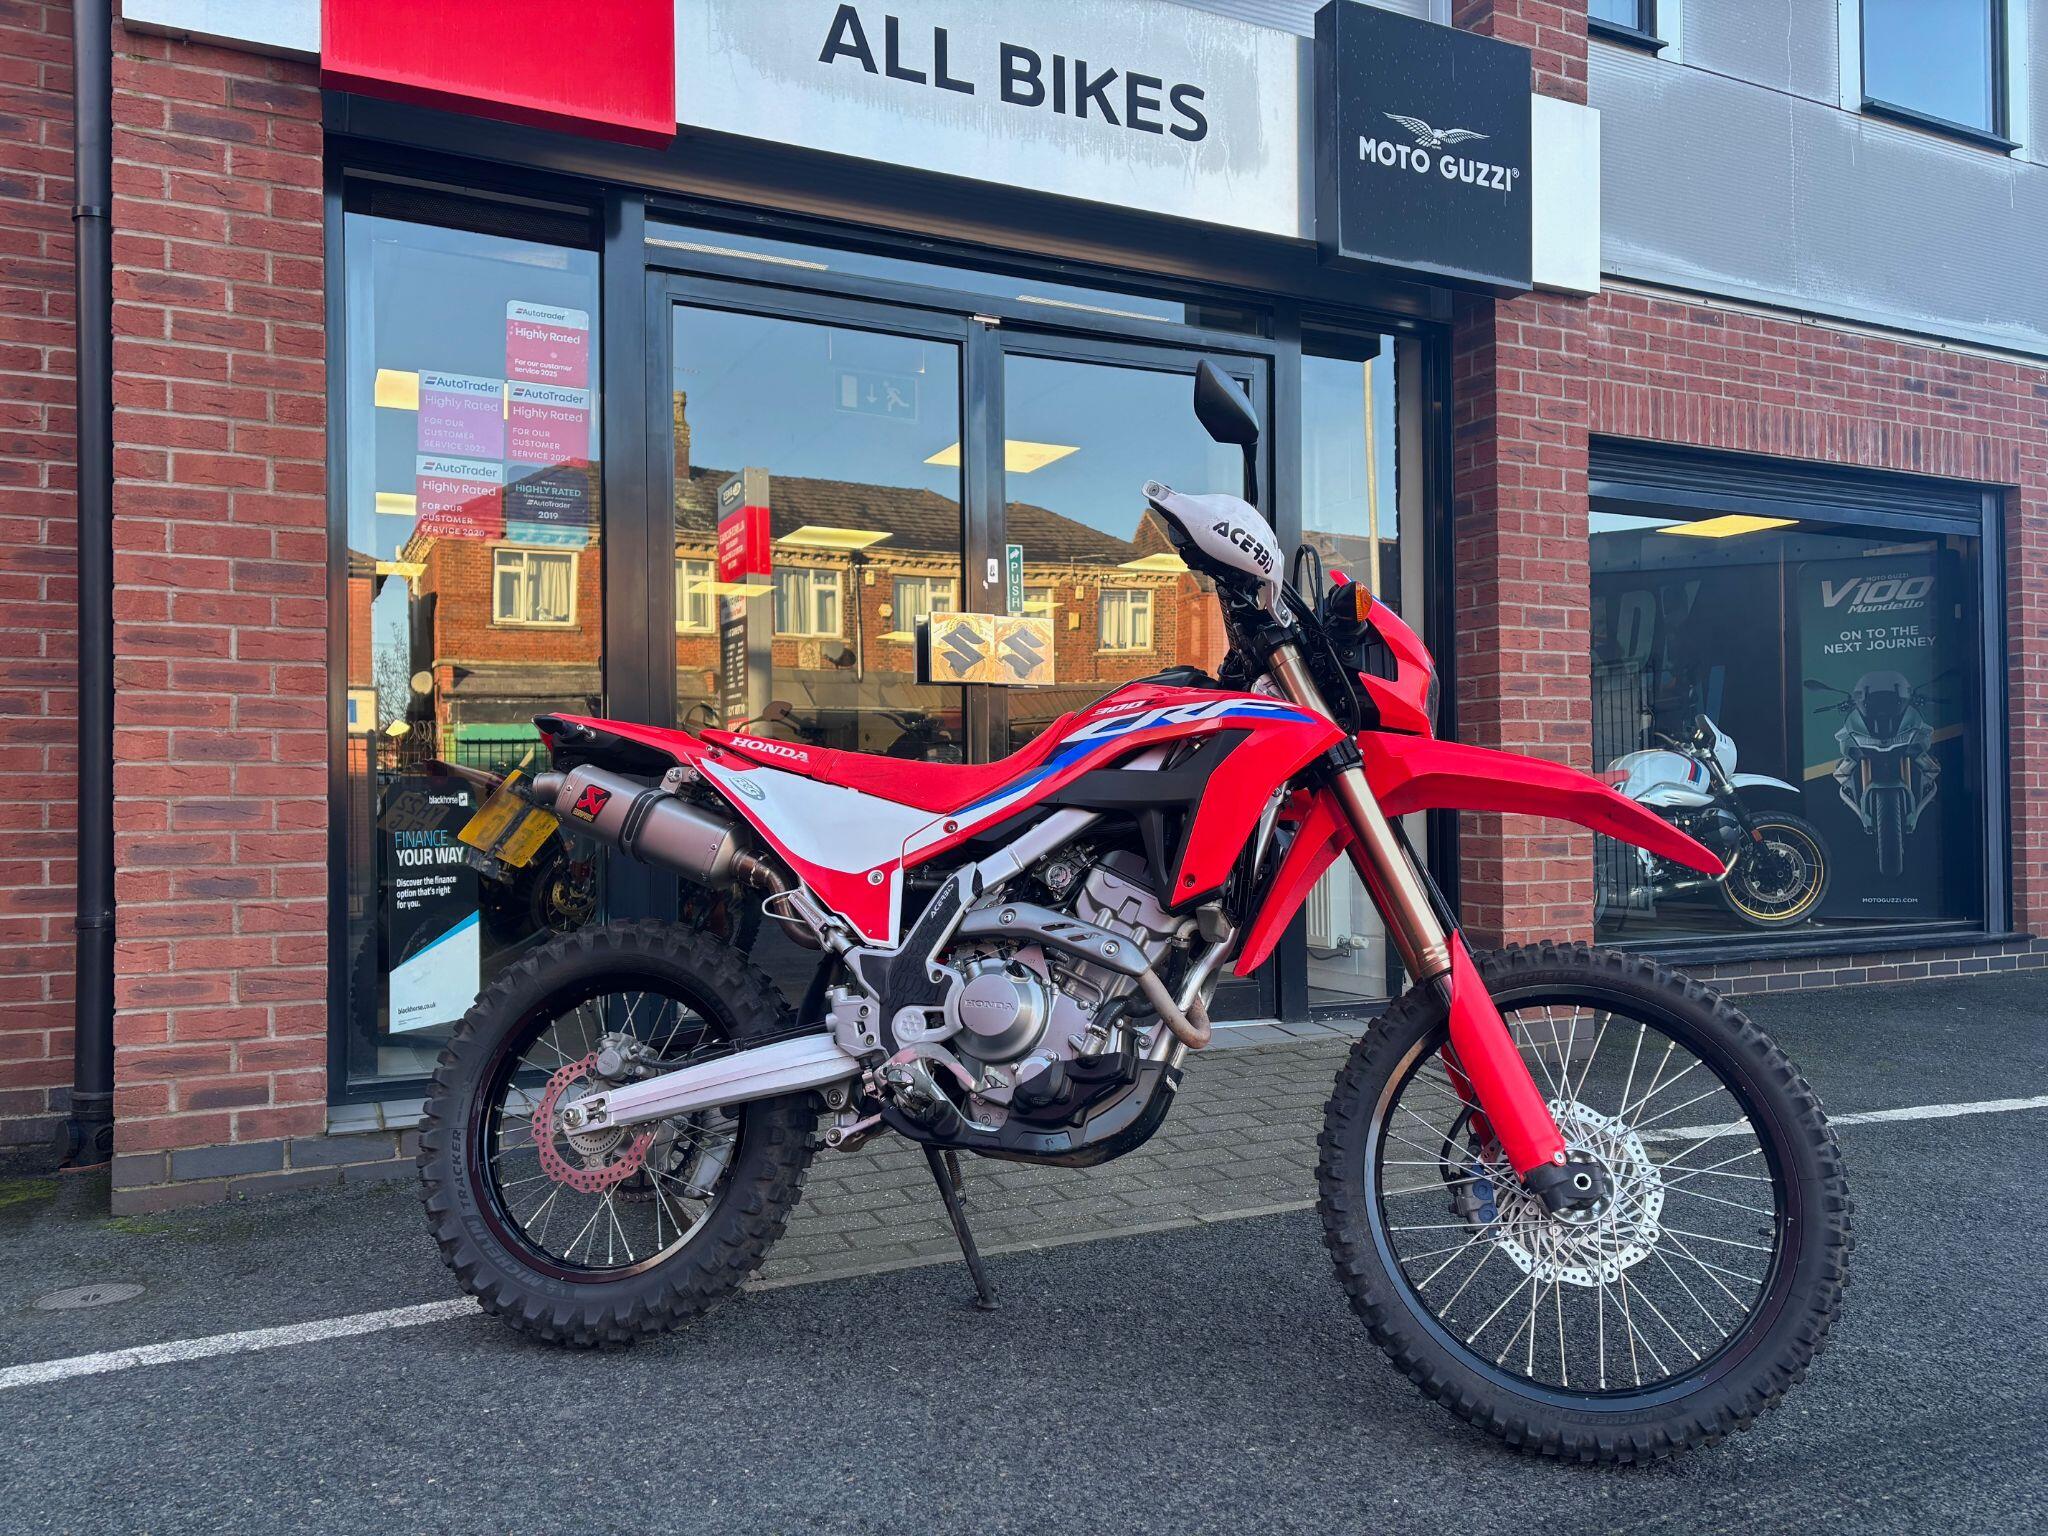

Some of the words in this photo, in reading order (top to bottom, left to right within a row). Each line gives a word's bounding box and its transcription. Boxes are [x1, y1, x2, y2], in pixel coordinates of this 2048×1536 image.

[817, 3, 975, 96] ALL
[999, 41, 1209, 143] BIKES
[1359, 135, 1431, 174] MOTO
[522, 308, 566, 321] Autotrader
[515, 327, 549, 342] Highly
[549, 332, 581, 344] Rated
[514, 358, 526, 366] For
[539, 362, 573, 372] customer
[514, 367, 540, 375] service
[436, 377, 500, 393] AutoTrader
[425, 394, 462, 410] Highly
[464, 399, 499, 412] Rated
[524, 389, 584, 404] AutoTrader
[513, 406, 548, 421] Highly
[550, 410, 583, 423] Rated
[424, 417, 442, 425] FOR
[445, 419, 464, 428] OUR
[424, 428, 474, 440] CUSTOMER
[512, 427, 530, 436] FOR
[532, 429, 550, 438] OUR
[424, 440, 463, 450] SERVICE
[512, 438, 561, 450] CUSTOMER
[512, 449, 548, 460] SERVICE
[550, 453, 571, 462] 2024
[434, 462, 497, 477] AutoTrader
[423, 480, 460, 494] Highly
[462, 484, 497, 496] Rated
[515, 483, 551, 495] HIGHLY
[551, 487, 582, 497] RATED
[422, 502, 441, 511] FOR
[443, 504, 463, 513] OUR
[533, 500, 571, 509] AutoTrader
[421, 513, 473, 525] CUSTOMER
[538, 511, 559, 520] 2019
[421, 525, 460, 535] SERVICE
[1011, 561, 1021, 608] PUSH
[1821, 575, 1935, 608] V100
[1847, 598, 1925, 614] Mandello
[1840, 630, 1862, 641] ON
[1866, 628, 1886, 639] TO
[1890, 625, 1919, 637] THE
[1824, 641, 1862, 655] NEXT
[1866, 635, 1937, 651] JOURNEY
[729, 736, 810, 763] HONDA
[428, 795, 459, 805] blackhorse
[394, 829, 449, 848] FINANCE
[396, 848, 433, 867] YOUR
[434, 846, 465, 864] WAY
[396, 878, 423, 888] Discover
[423, 876, 434, 886] the
[434, 875, 457, 884] finance
[396, 888, 417, 900] option
[417, 886, 436, 897] that's
[435, 885, 451, 897] right
[396, 900, 407, 910] for
[407, 901, 421, 911] you.
[397, 1001, 437, 1015] blackhorse.co.uk
[964, 999, 1015, 1011] HONDA
[451, 1128, 472, 1210] TRACKER
[465, 1219, 545, 1288] MICHELIN
